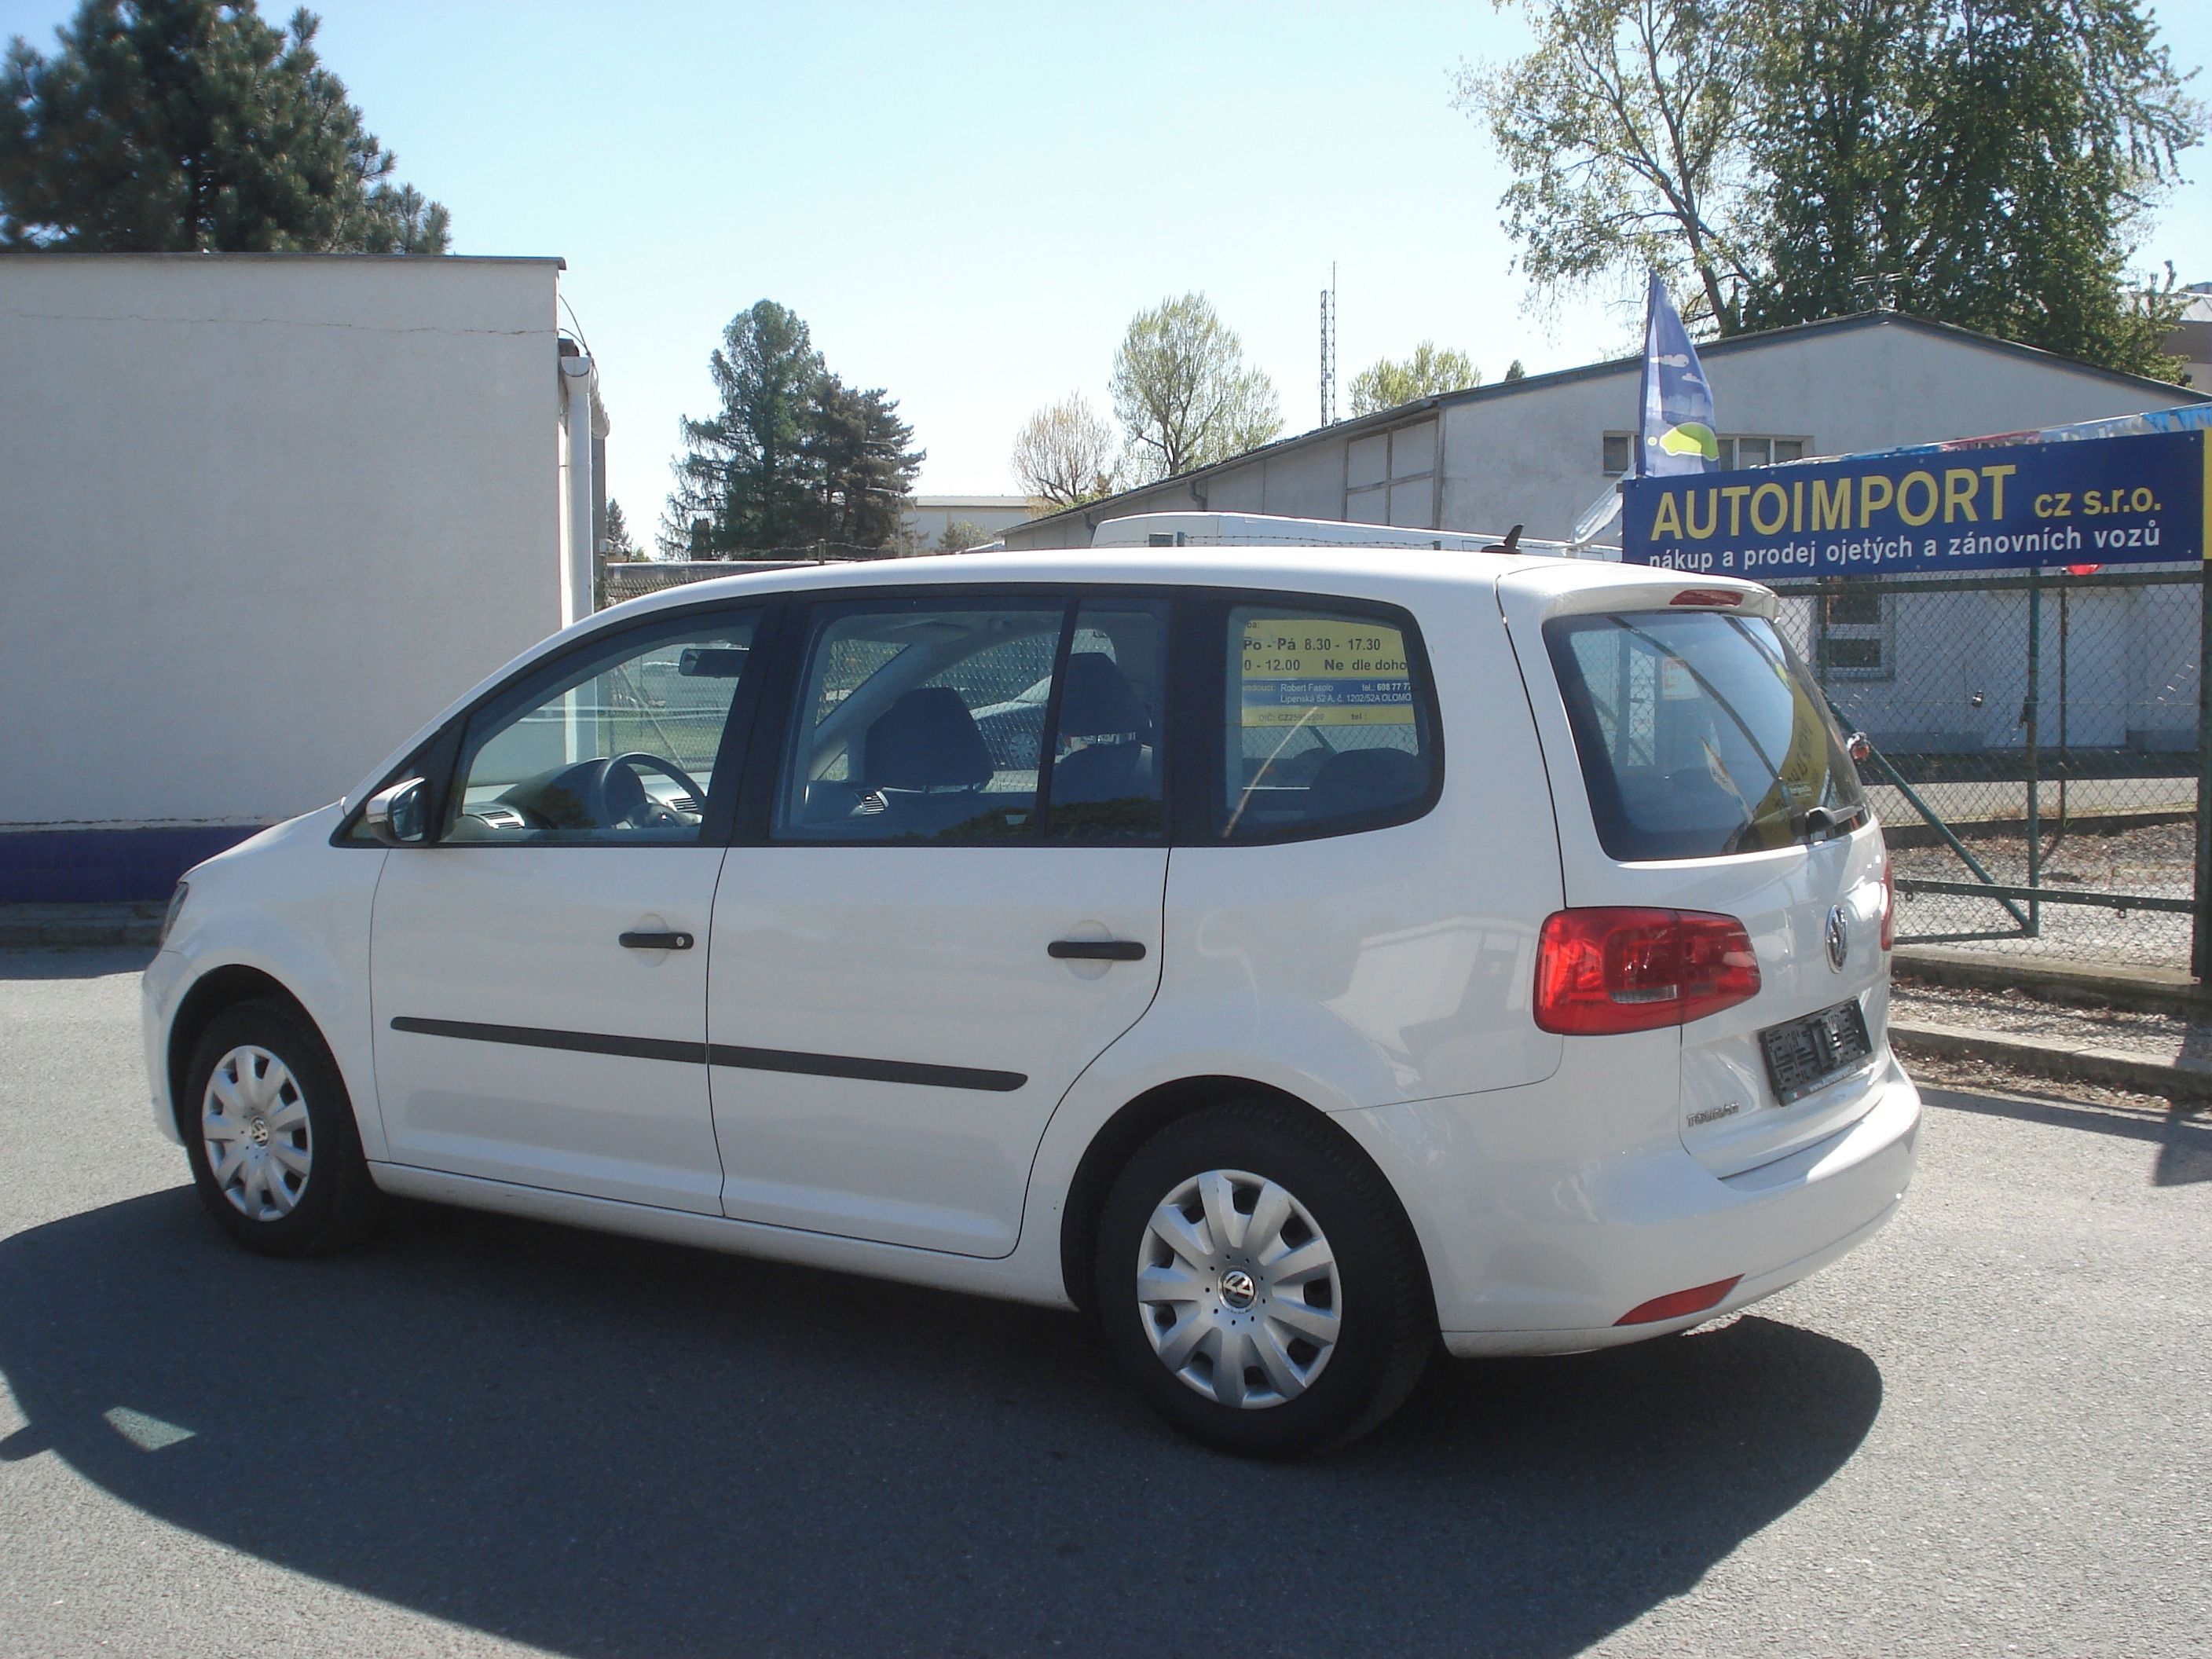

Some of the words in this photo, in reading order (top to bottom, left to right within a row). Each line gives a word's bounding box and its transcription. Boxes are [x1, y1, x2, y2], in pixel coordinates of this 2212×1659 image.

[1650, 464, 2016, 540] AUTOIMPORT
[2034, 493, 2071, 518] cz
[2083, 487, 2161, 515] s.r.o.
[1650, 549, 1713, 572] nákup
[1722, 551, 1734, 567] a
[1744, 541, 1816, 570] prodej
[1826, 535, 1912, 566] ojetých
[1925, 539, 1936, 557] a
[1948, 526, 2081, 555] zánovních
[2094, 519, 2159, 548] vozů
[1243, 639, 1262, 650] Po
[1277, 637, 1296, 650] Pá
[1305, 638, 1331, 650] 8.30
[1348, 638, 1380, 650] 17.30
[1265, 659, 1300, 671] 12.00
[1324, 659, 1344, 670] Ne
[1352, 659, 1371, 670] dle
[1280, 683, 1306, 692] Robert
